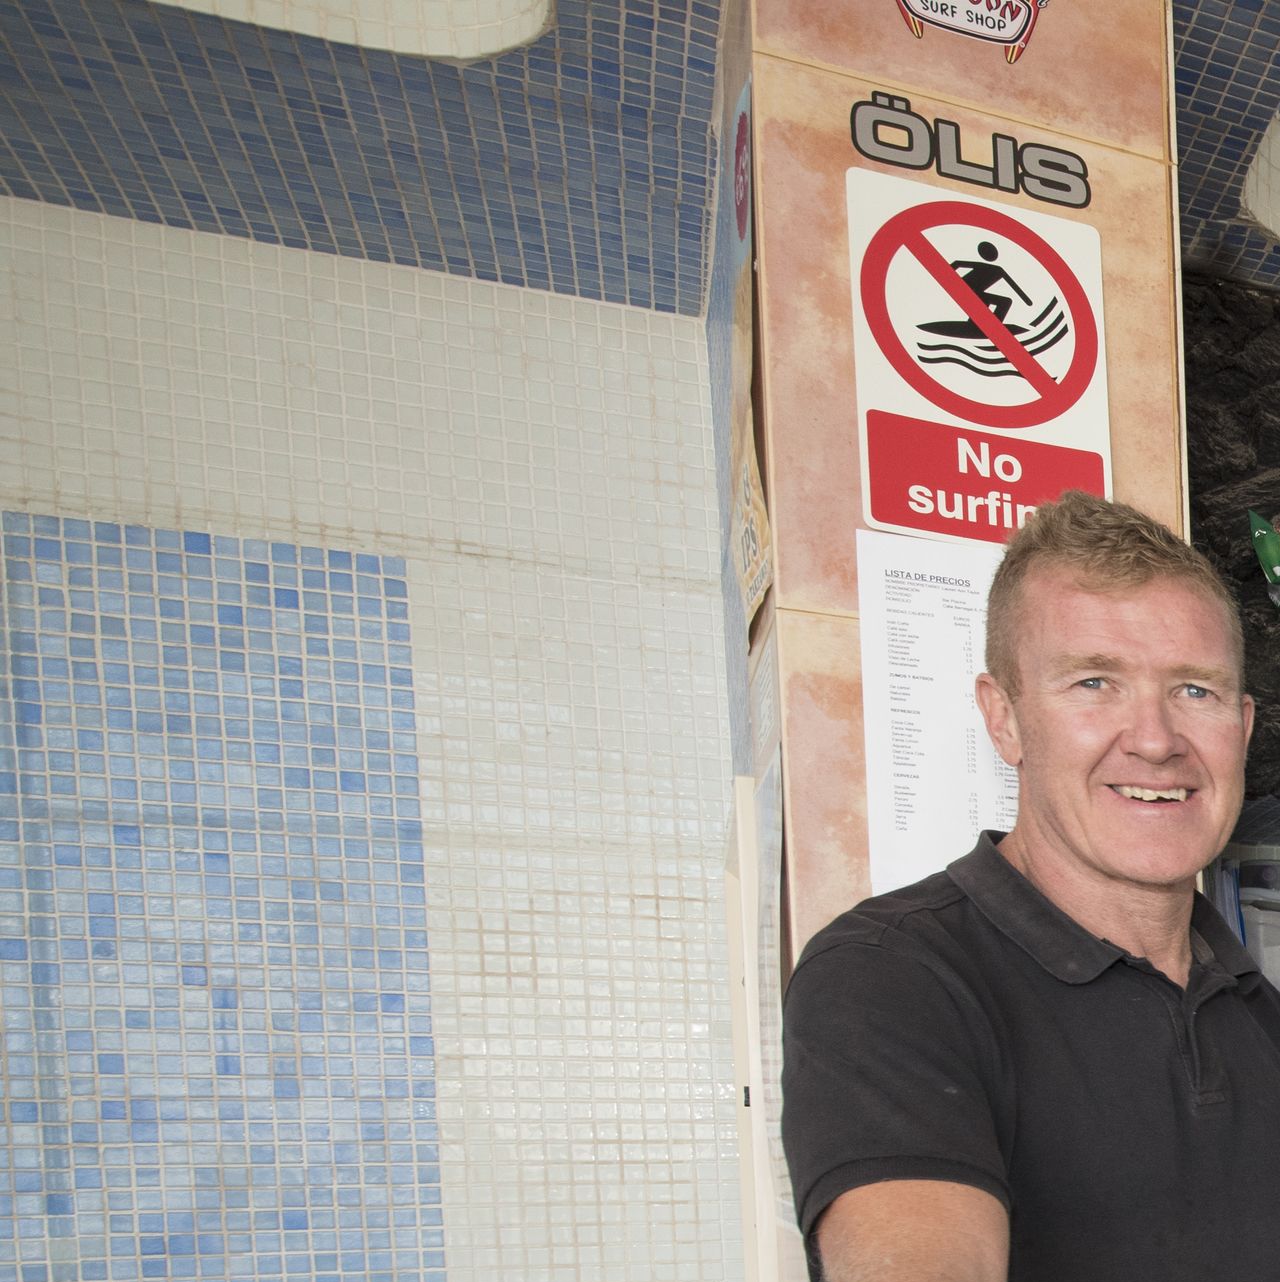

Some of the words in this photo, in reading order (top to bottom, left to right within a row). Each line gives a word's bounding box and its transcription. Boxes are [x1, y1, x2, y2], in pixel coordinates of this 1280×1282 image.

[966, 10, 1006, 31] SHOP
[957, 437, 1023, 483] No
[908, 484, 1038, 529] surfin
[885, 569, 912, 579] LISTA
[914, 572, 927, 581] DE
[929, 575, 971, 588] PRECIOS
